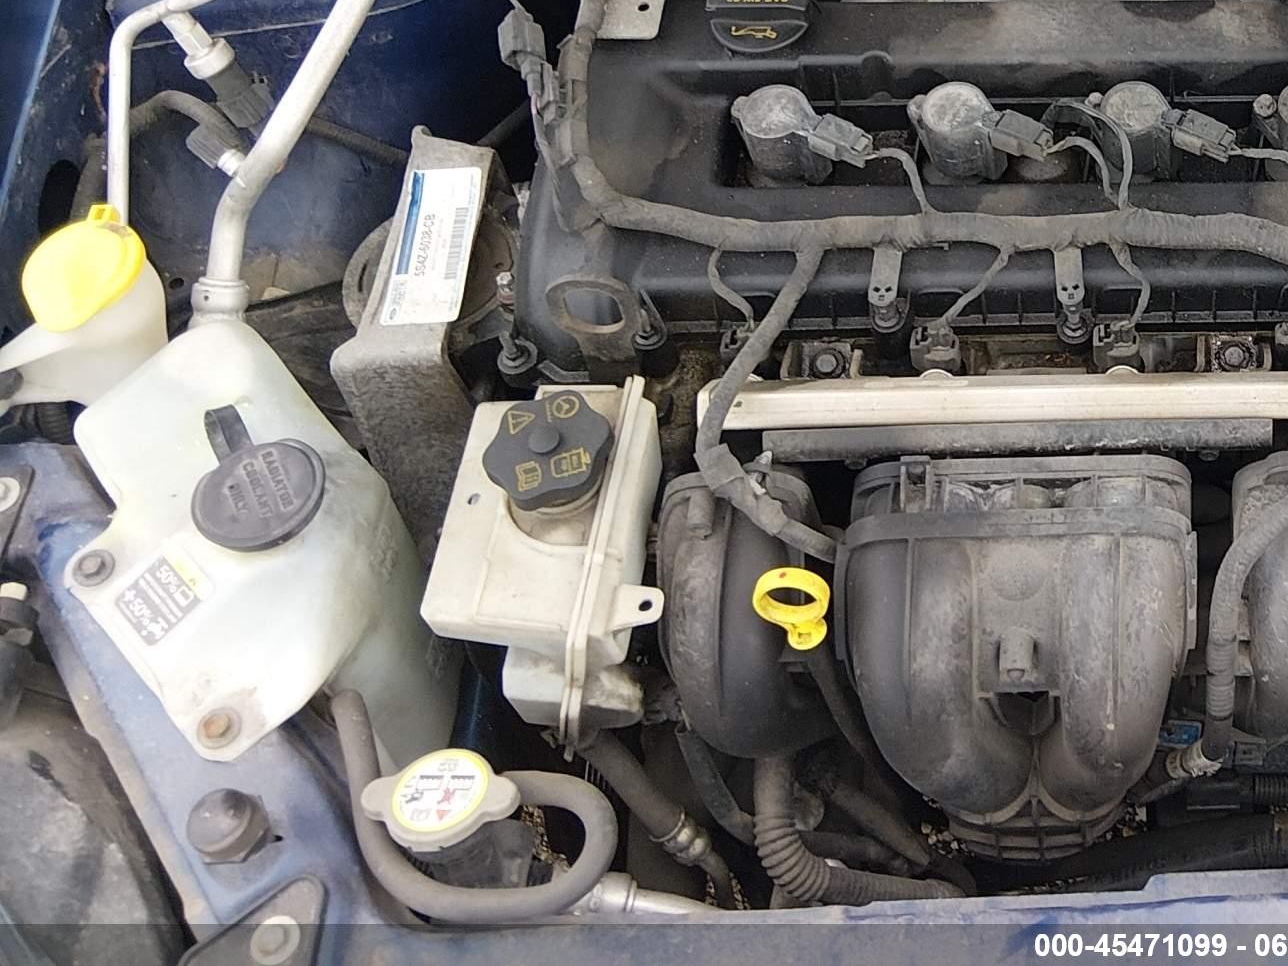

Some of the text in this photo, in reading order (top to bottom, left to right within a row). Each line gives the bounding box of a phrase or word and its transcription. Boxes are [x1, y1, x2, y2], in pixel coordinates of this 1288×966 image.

[414, 214, 435, 277] 5S4Z-6038-CB
[227, 484, 250, 515] ONLY
[242, 460, 274, 517] COOLANT
[261, 450, 295, 509] RADIATOR
[155, 566, 181, 592] 50%
